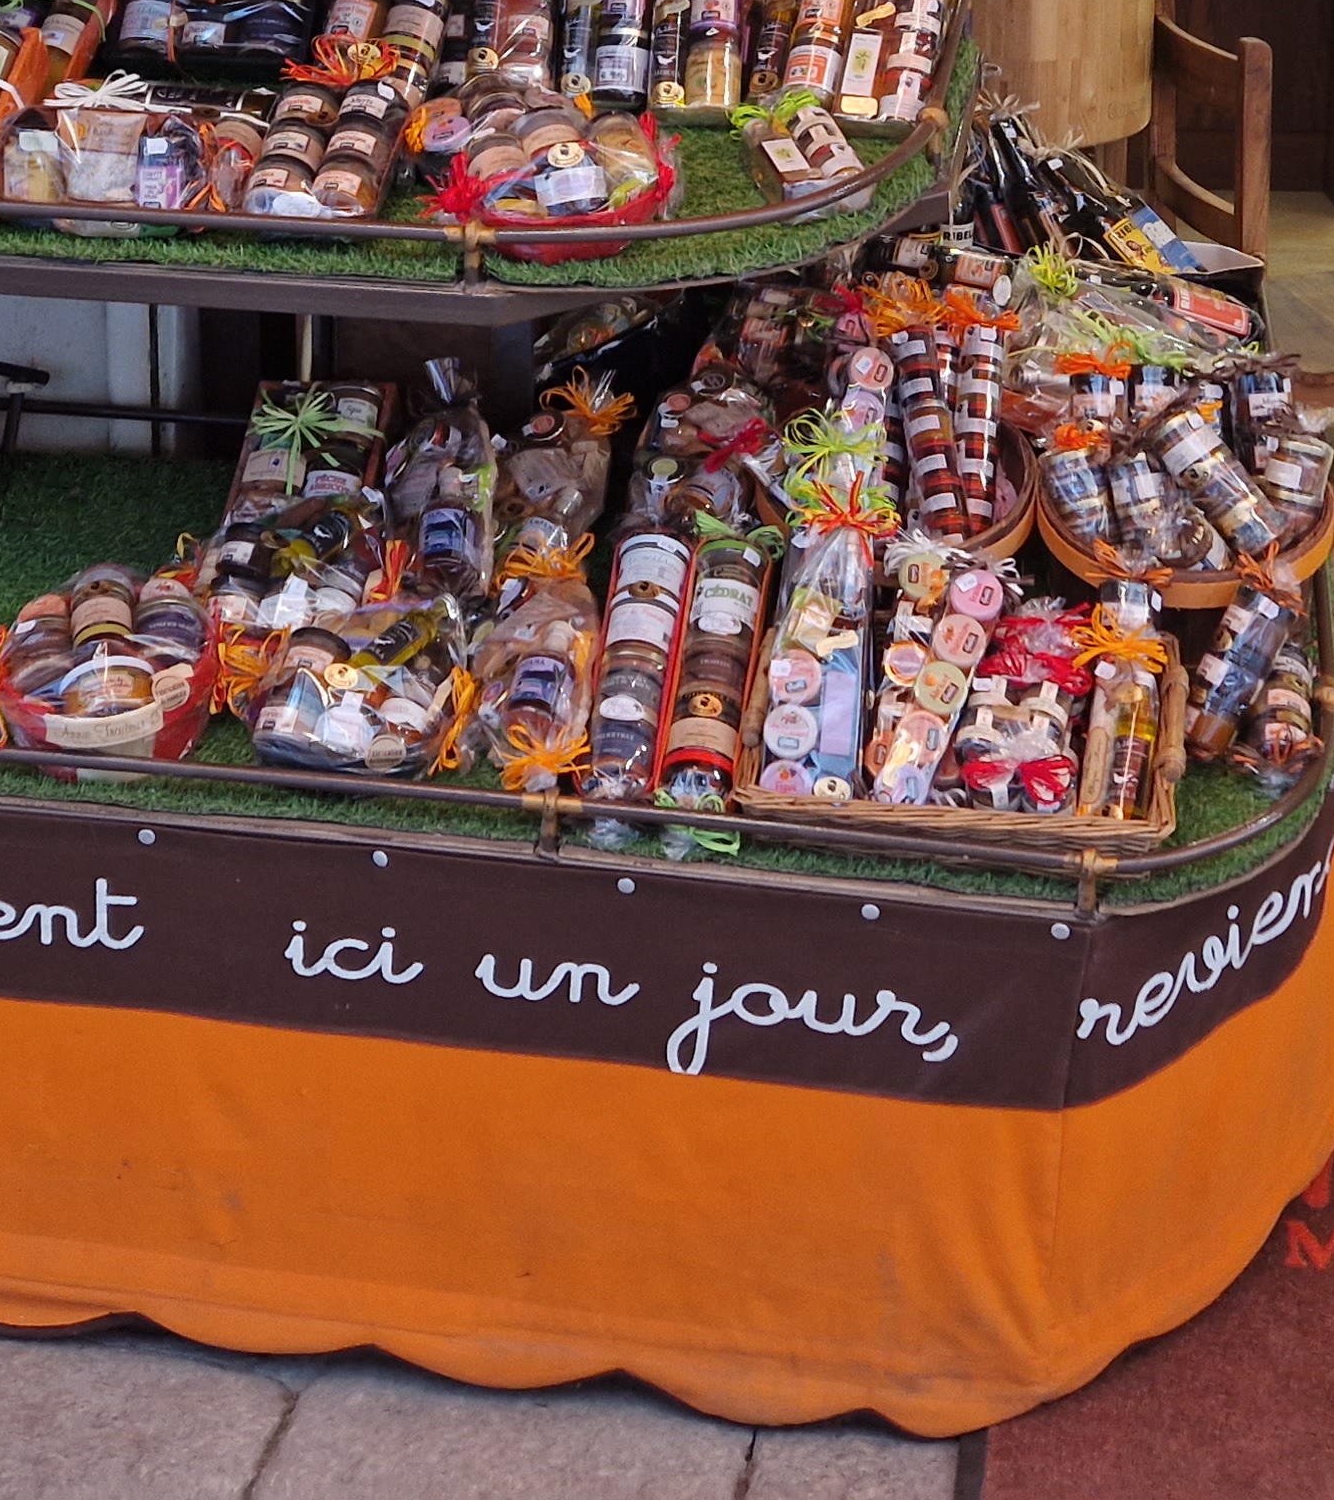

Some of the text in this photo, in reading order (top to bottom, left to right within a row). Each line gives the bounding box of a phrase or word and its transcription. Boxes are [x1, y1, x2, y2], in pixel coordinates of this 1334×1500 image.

[704, 586, 753, 607] CÉDRAT
[284, 918, 424, 986] ici
[471, 948, 639, 1008] un
[670, 960, 962, 1075] jour,
